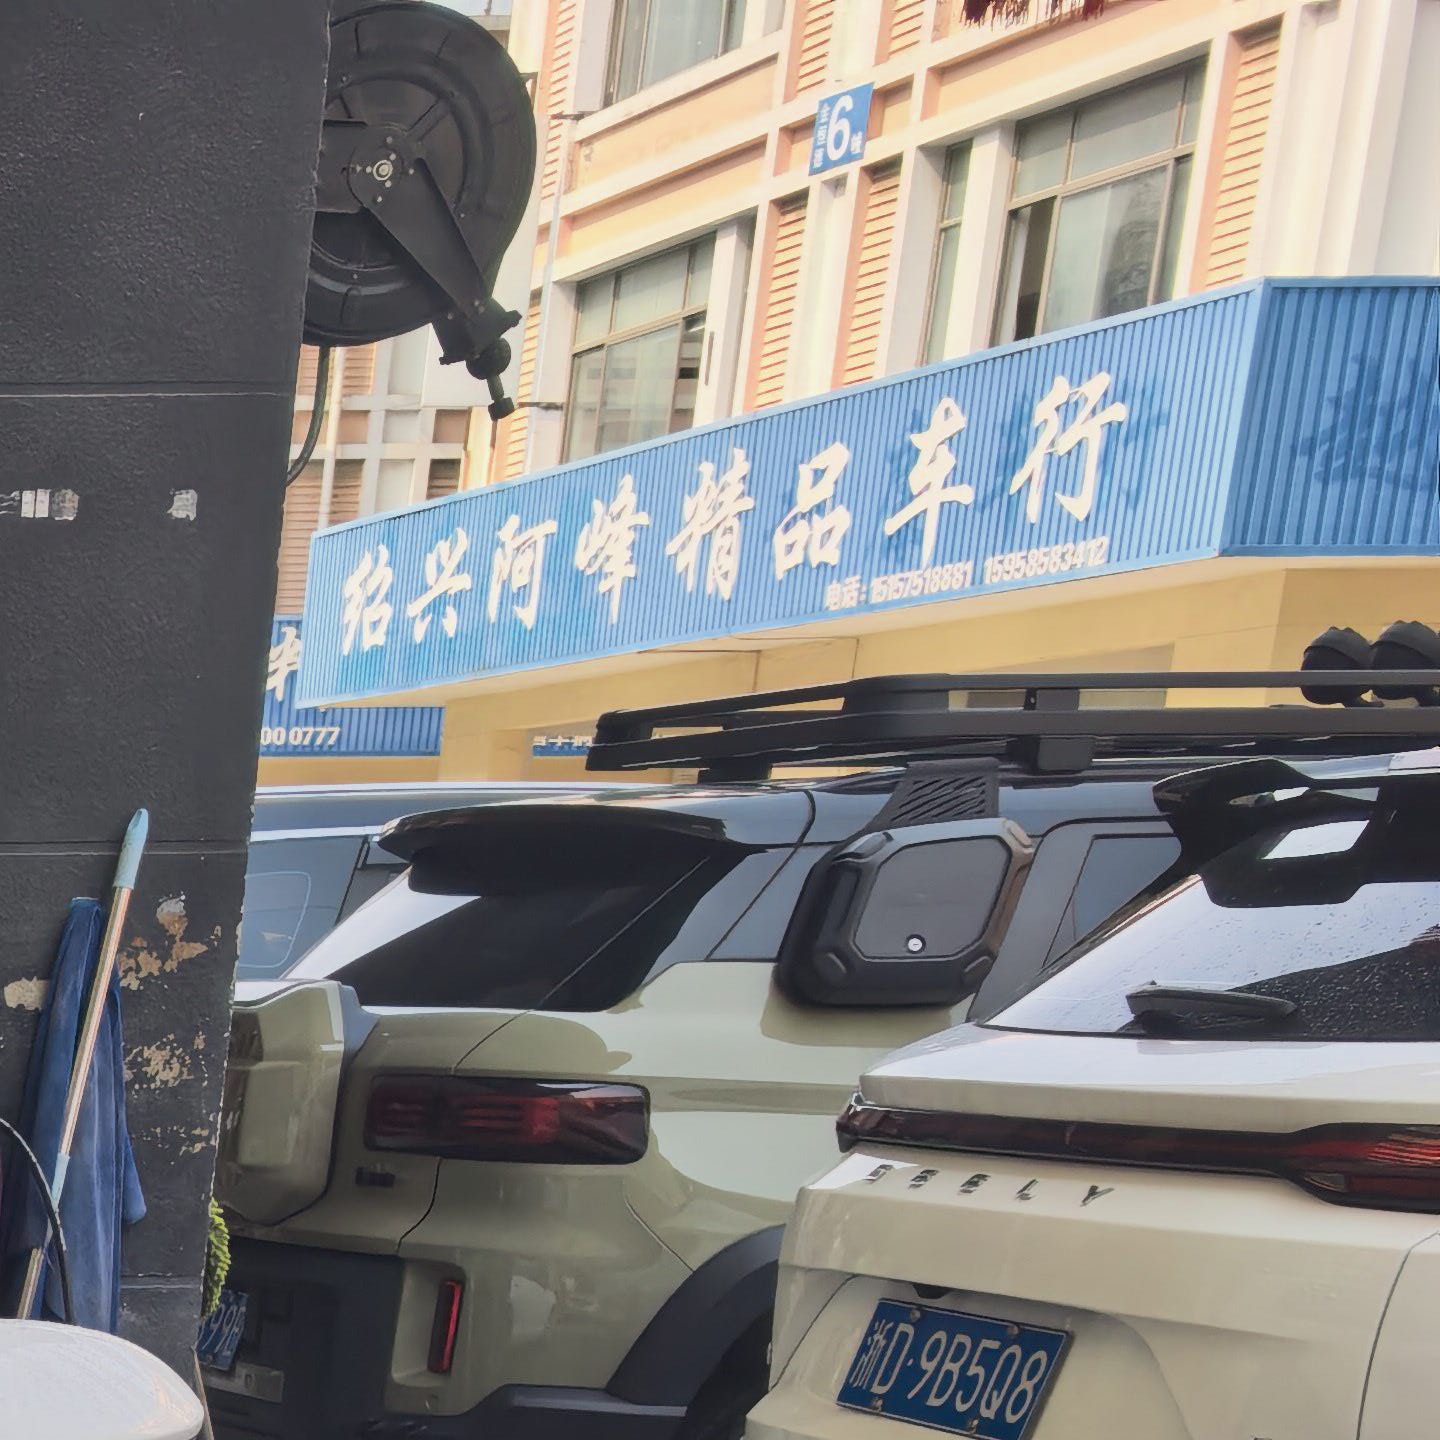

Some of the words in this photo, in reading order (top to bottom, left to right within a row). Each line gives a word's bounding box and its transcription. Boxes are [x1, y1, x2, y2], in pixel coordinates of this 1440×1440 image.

[342, 371, 1127, 656] 绍兴阿峰精品车行
[983, 535, 1110, 586] 15958583412
